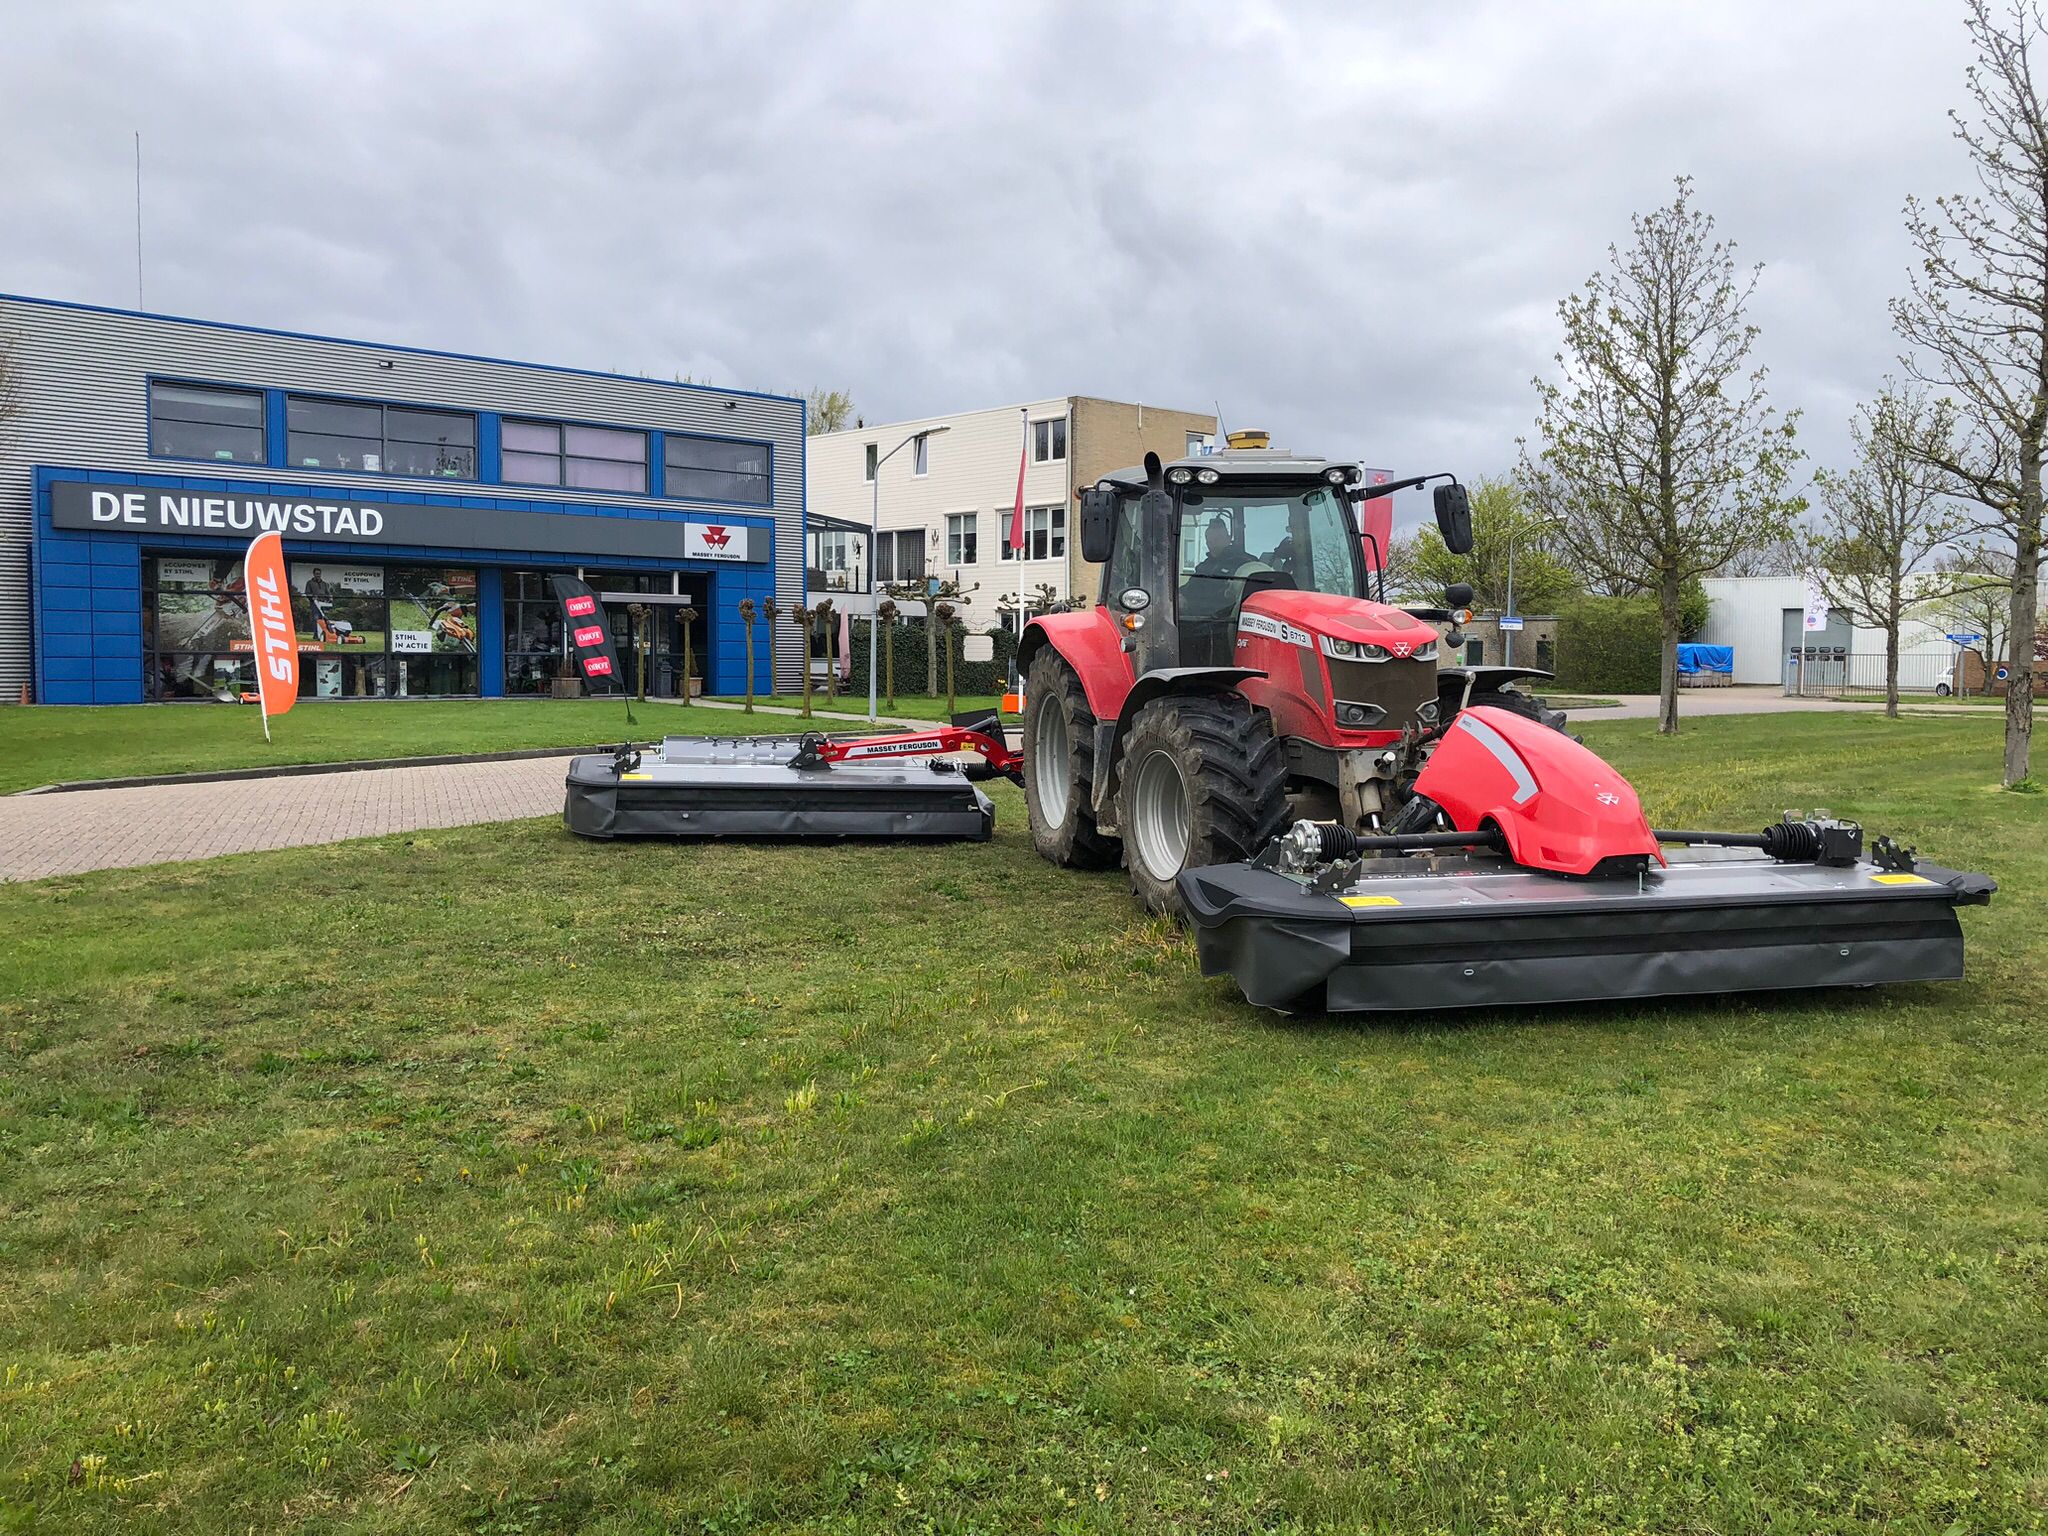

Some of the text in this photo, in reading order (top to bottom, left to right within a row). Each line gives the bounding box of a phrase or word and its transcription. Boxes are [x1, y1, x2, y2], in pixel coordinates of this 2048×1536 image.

[92, 491, 383, 536] DE NIEUWSTAD
[256, 567, 292, 684] STIHL
[1281, 624, 1288, 640] S
[233, 643, 254, 651] STIH
[867, 741, 938, 753] MASSEY FERGUSON
